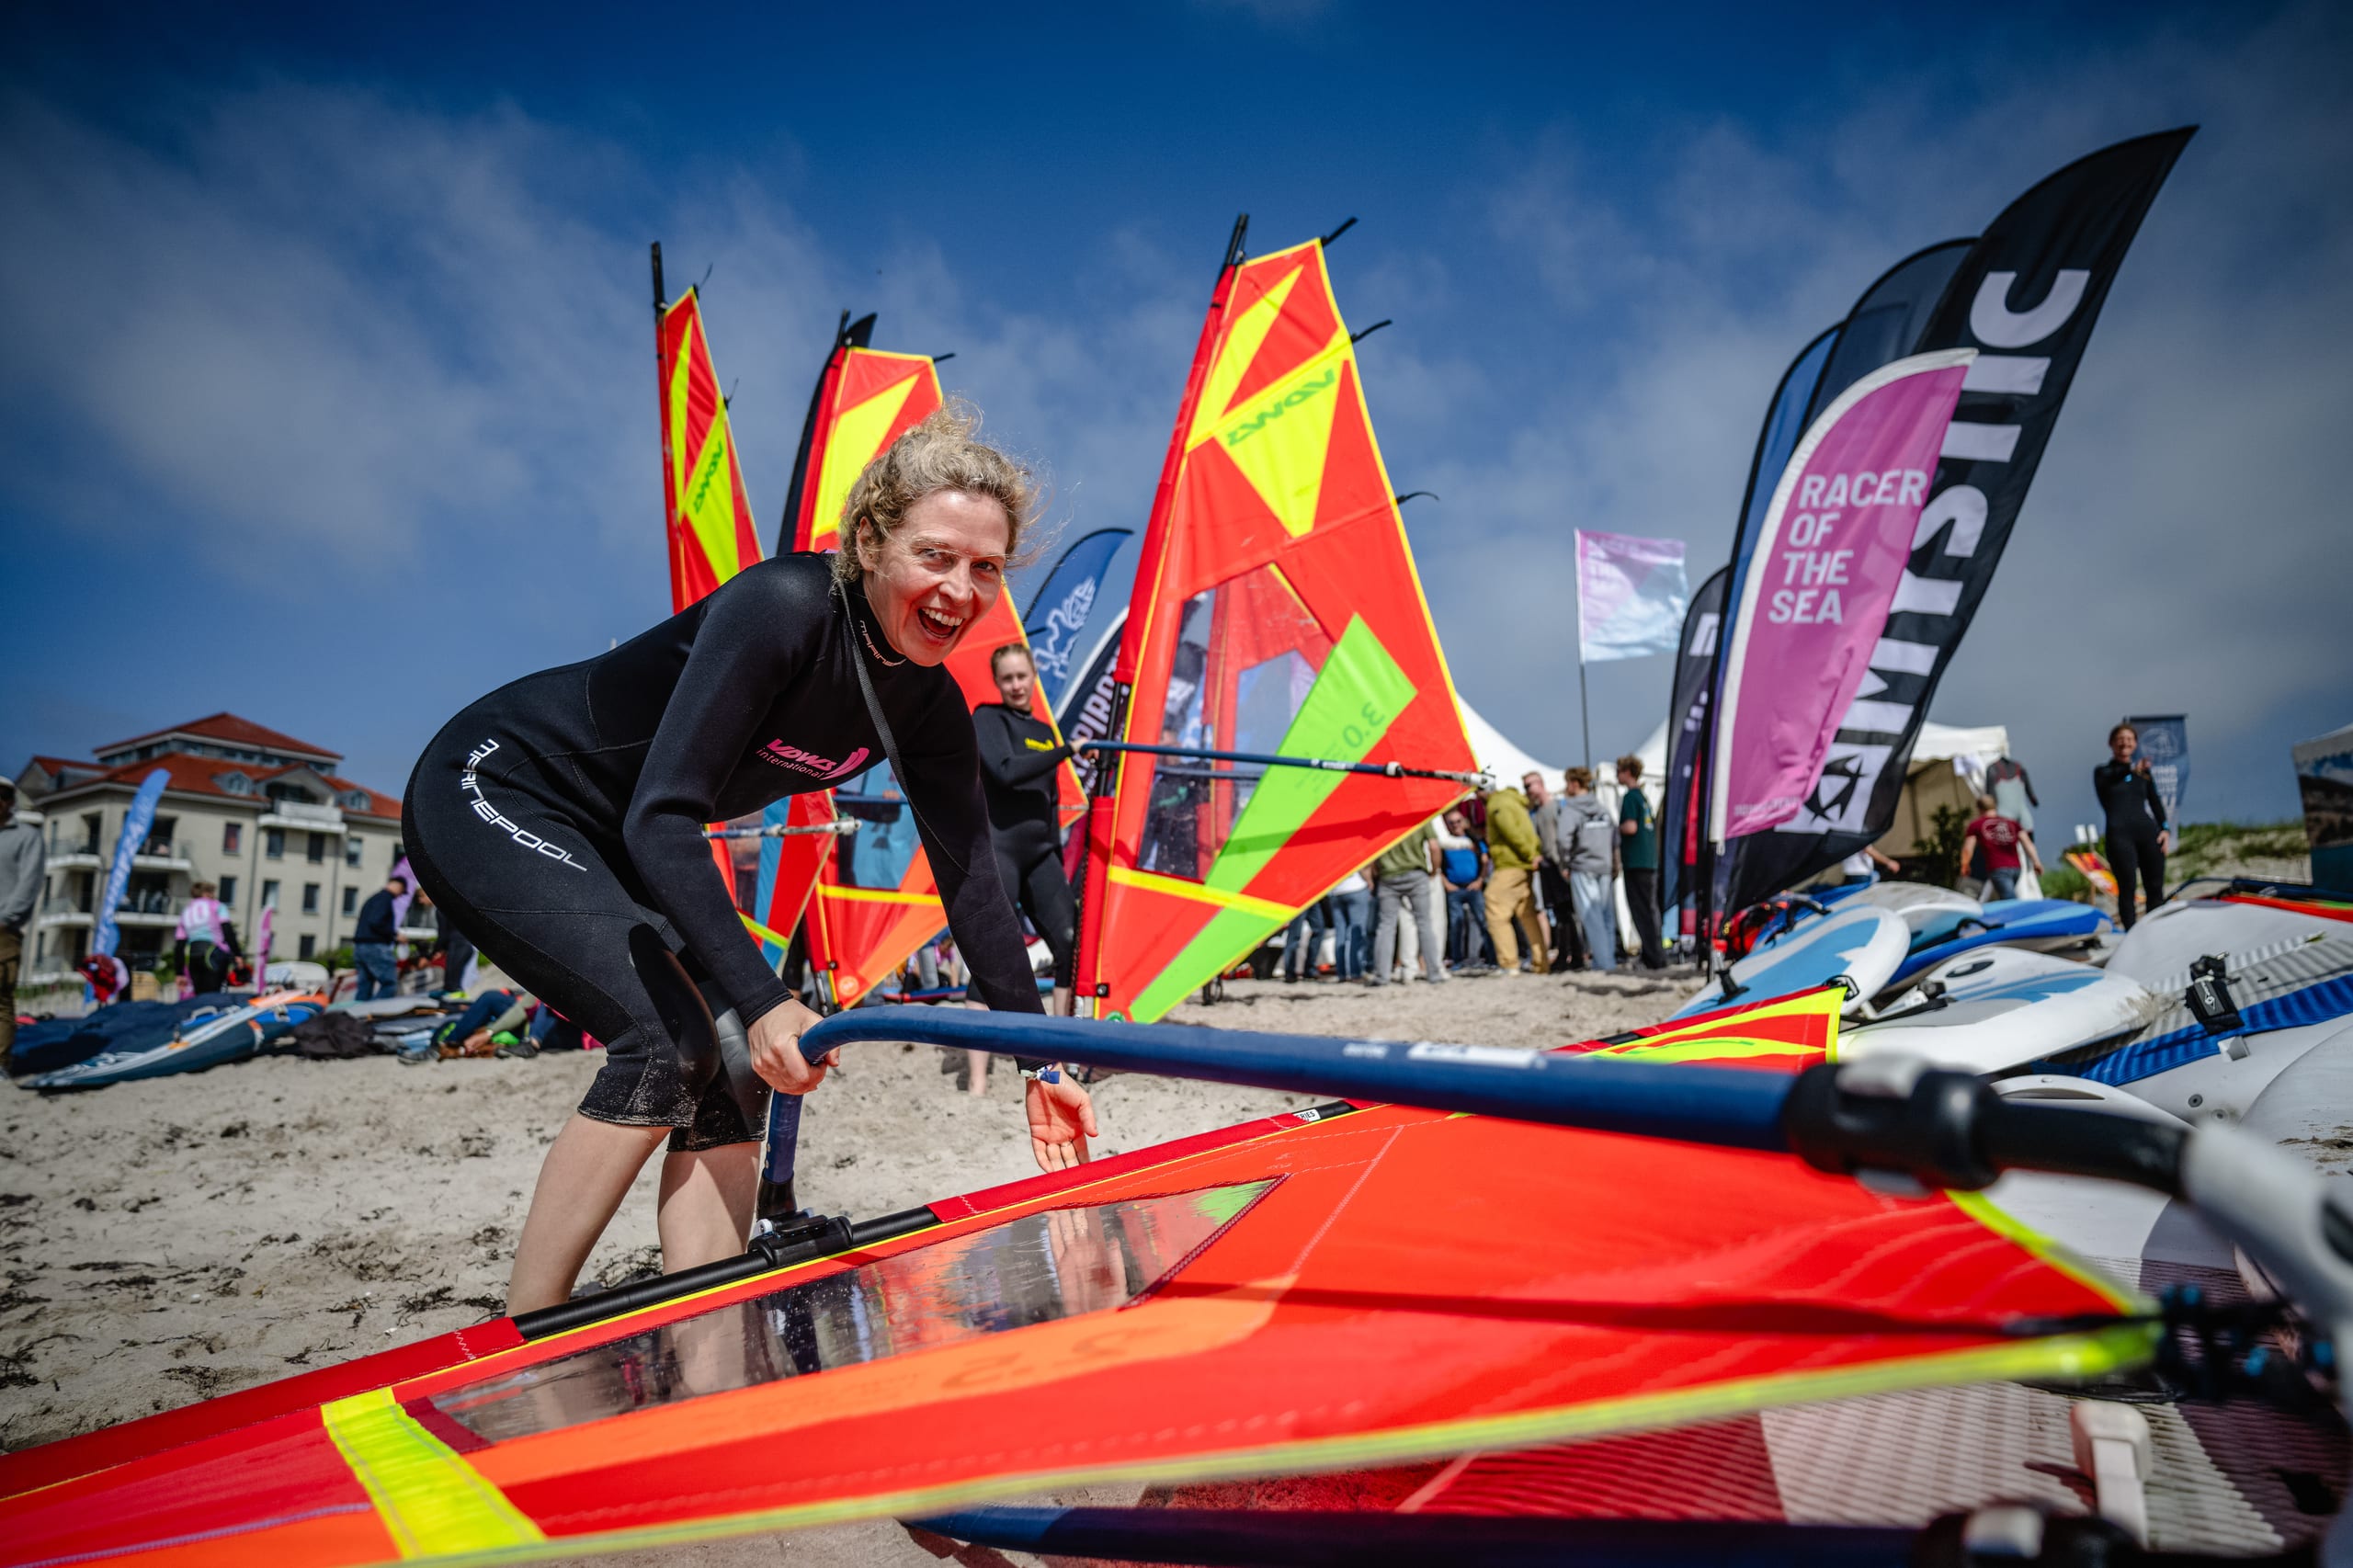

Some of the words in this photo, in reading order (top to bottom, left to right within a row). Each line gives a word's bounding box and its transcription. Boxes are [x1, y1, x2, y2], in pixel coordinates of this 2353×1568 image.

[1798, 469, 1928, 509] RACER
[1788, 512, 1841, 547] OF
[1783, 550, 1854, 585] THE
[1768, 589, 1843, 625] SEA
[755, 747, 826, 779] international
[461, 739, 587, 871] MARINEPOOL
[1296, 1110, 1315, 1120] RIES
